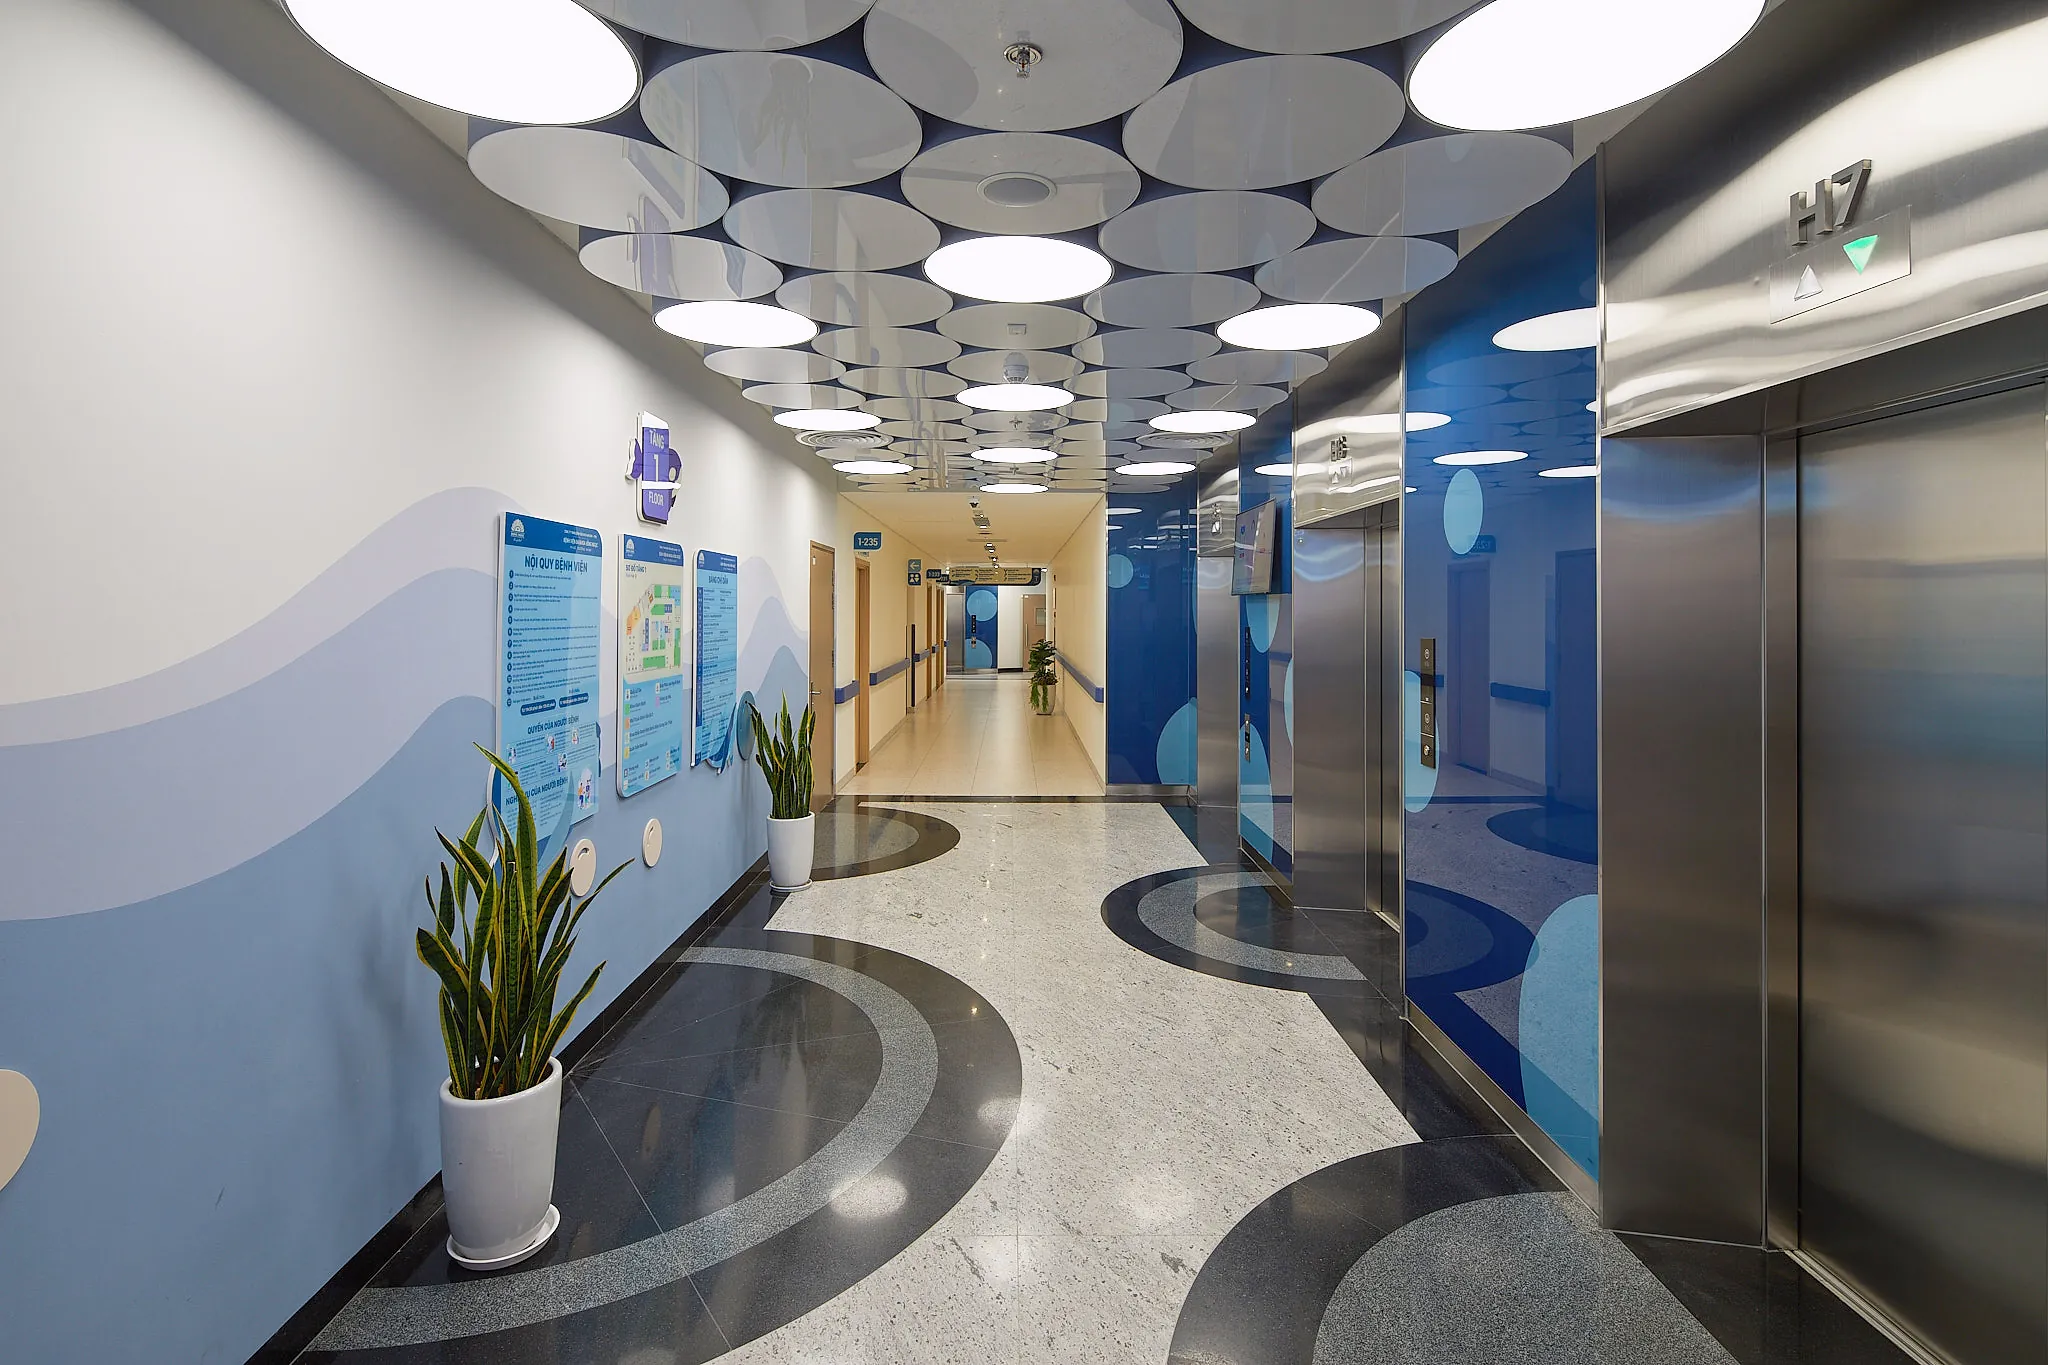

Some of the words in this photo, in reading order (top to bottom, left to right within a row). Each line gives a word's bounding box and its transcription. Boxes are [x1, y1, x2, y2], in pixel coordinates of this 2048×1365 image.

[1790, 159, 1872, 246] H7
[649, 429, 665, 449] TẦNG
[653, 453, 659, 482] 1
[648, 491, 664, 506] FLOOR
[857, 537, 878, 547] 1-235
[525, 554, 538, 571] NỘI
[539, 557, 554, 570] QUY
[555, 557, 573, 573] BỆNH
[574, 560, 588, 575] VIỆN
[527, 722, 544, 735] QUYỀN
[544, 720, 553, 731] CỦA
[505, 795, 518, 806] NGH
